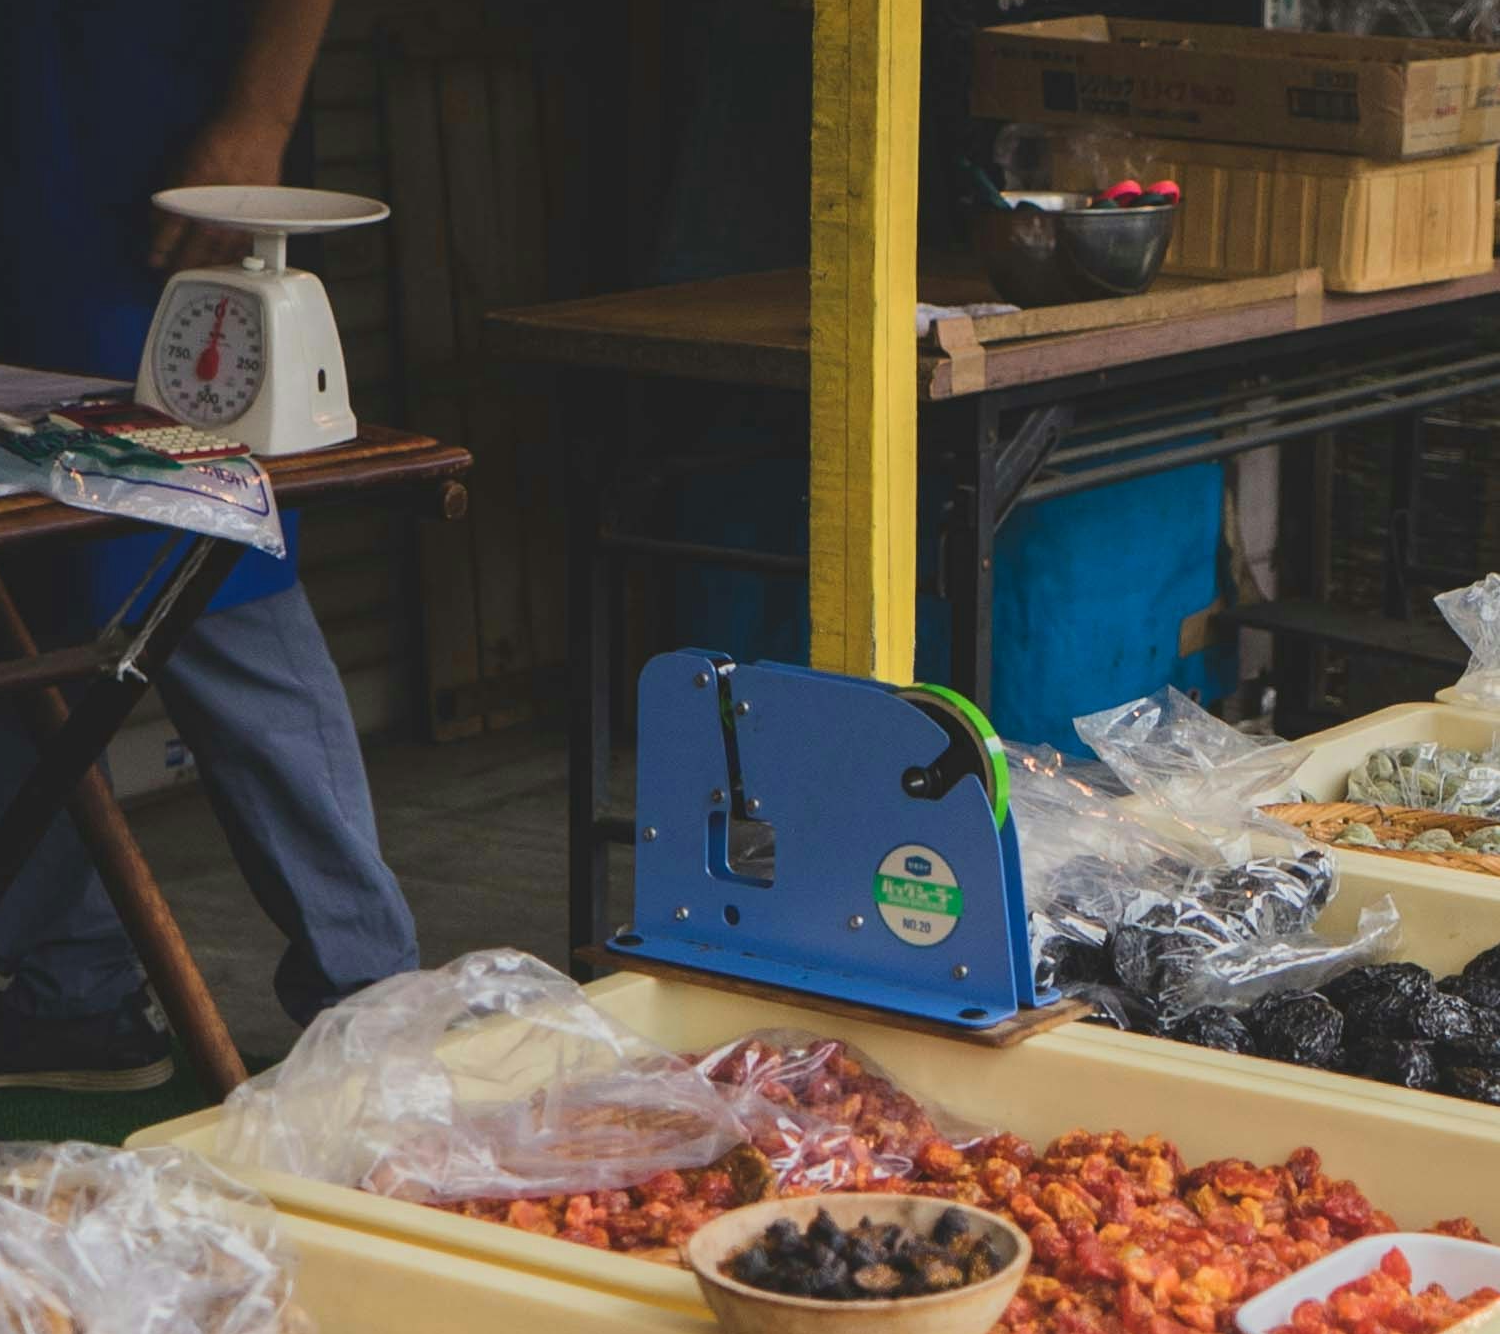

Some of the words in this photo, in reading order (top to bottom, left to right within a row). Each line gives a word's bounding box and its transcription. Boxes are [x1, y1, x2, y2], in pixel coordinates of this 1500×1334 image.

[167, 346, 190, 359] 750
[236, 356, 260, 371] 250
[196, 391, 219, 404] 500
